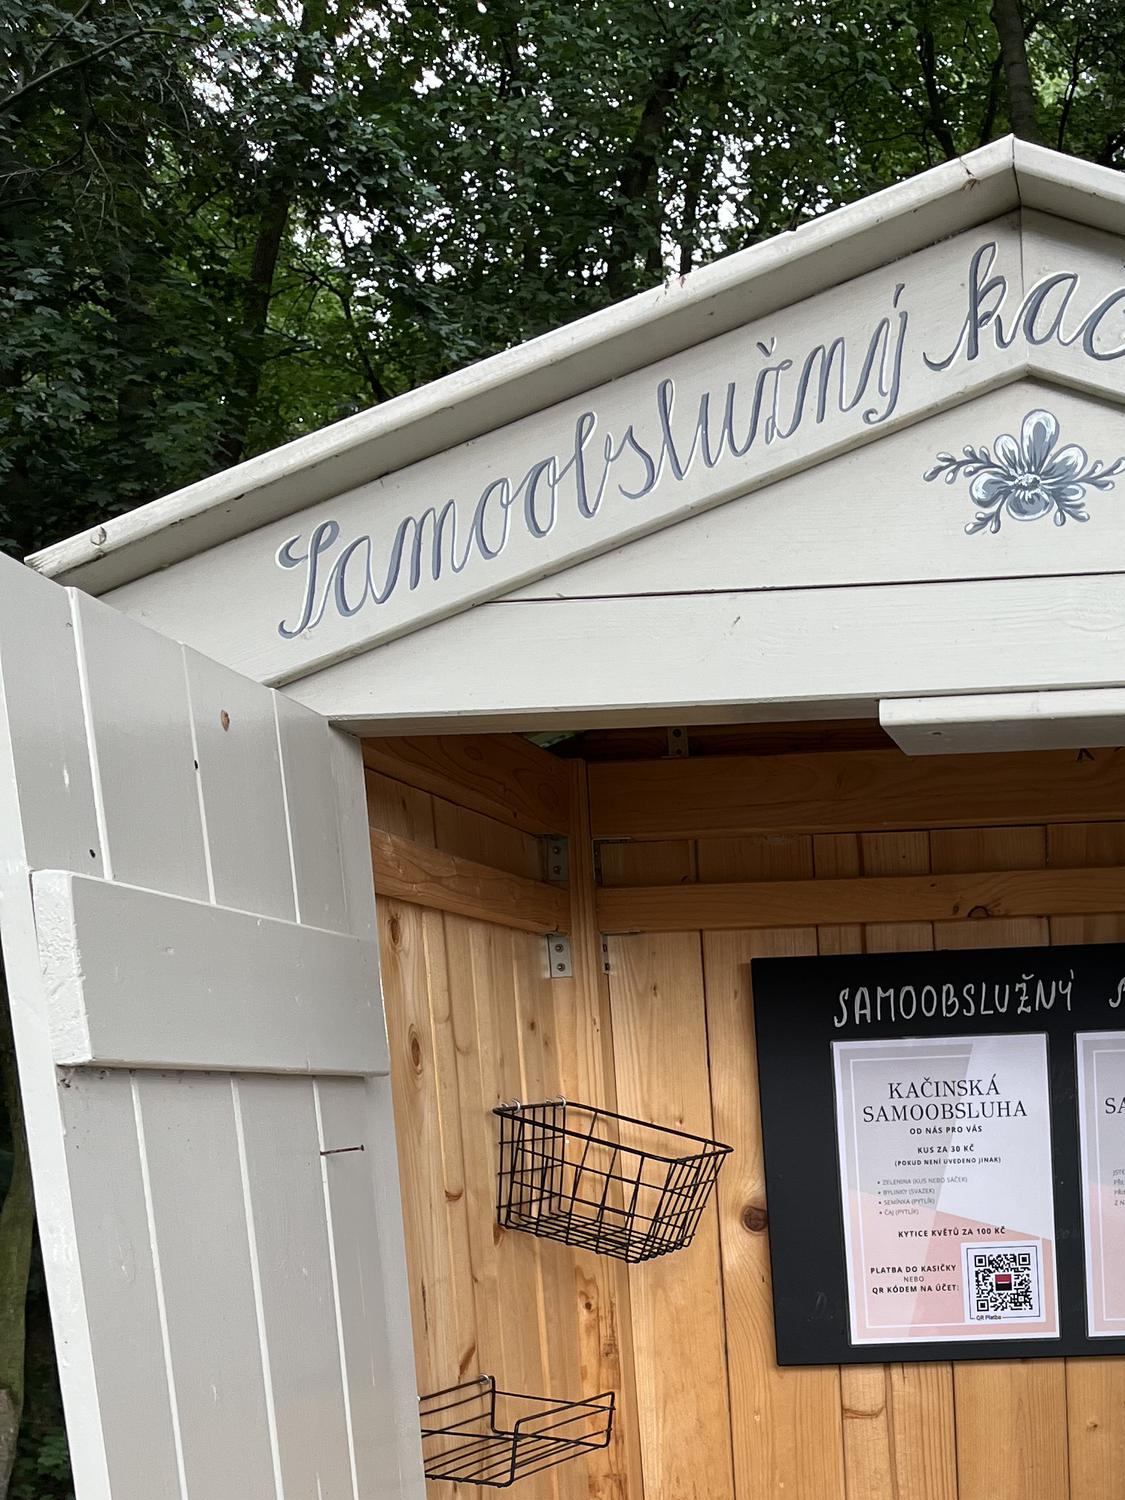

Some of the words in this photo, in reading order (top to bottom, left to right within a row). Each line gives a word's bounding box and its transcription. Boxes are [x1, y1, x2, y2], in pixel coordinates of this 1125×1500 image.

[833, 969, 1075, 1028] SAMOOBSLUŽNÝ
[888, 1073, 1001, 1100] KAČINSKÁ
[863, 1100, 1028, 1123] SAMOOBSLUHA
[909, 1127, 922, 1135] OD
[925, 1125, 943, 1135] NÁS
[946, 1126, 963, 1134] PRO
[966, 1124, 983, 1133] VÁS
[917, 1146, 935, 1154] KUS
[936, 1145, 948, 1153] ZA
[950, 1145, 961, 1153] 30
[963, 1143, 975, 1152] KČ
[894, 1159, 922, 1167] (POKUD
[923, 1157, 942, 1166] NENÍ
[943, 1157, 976, 1165] UVEDENO
[978, 1156, 1001, 1165] JINAK)
[898, 1229, 928, 1238] KYTICE
[931, 1227, 960, 1237] KVĚTŮ
[962, 1227, 974, 1236] ZA
[976, 1227, 992, 1235] 100
[994, 1225, 1006, 1235] KČ
[870, 1265, 903, 1274] PLATBA
[905, 1264, 919, 1273] DO
[921, 1262, 957, 1272] KASIČKY
[903, 1275, 925, 1283] NEBO
[872, 1286, 885, 1295] QR
[887, 1284, 918, 1294] KÓDEM
[920, 1284, 933, 1293] NA
